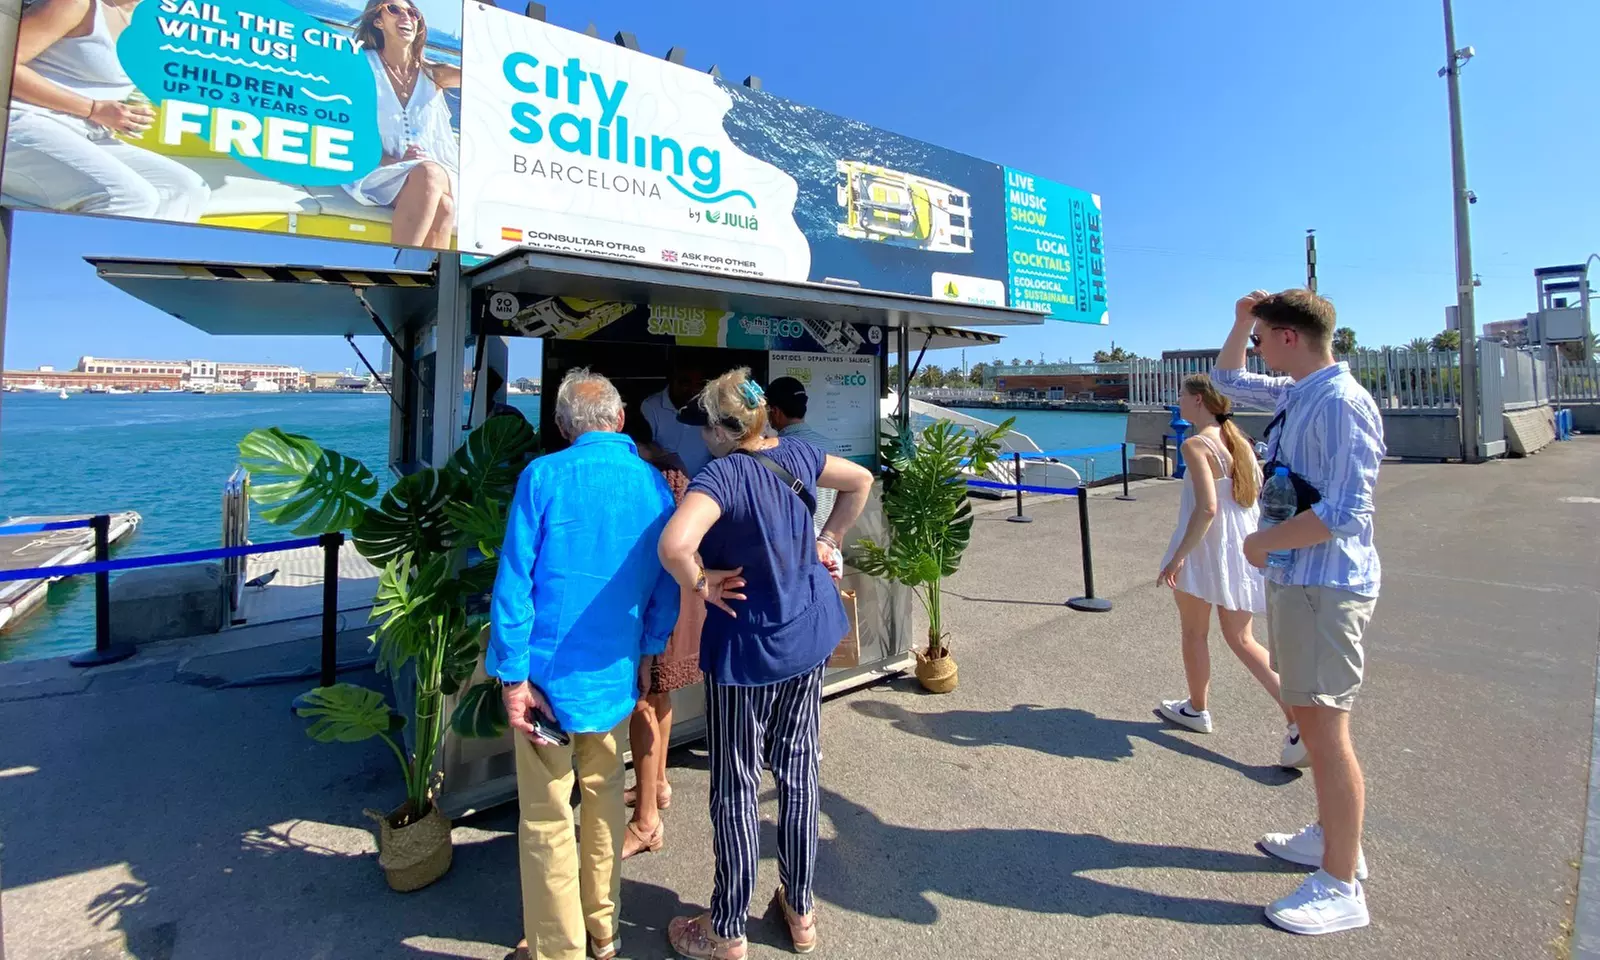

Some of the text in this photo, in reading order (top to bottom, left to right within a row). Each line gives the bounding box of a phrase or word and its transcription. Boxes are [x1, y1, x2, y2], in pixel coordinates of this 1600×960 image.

[159, 0, 365, 55] SAIL THE CITY
[157, 16, 297, 62] WITH US!
[163, 62, 295, 99] CHILDREN
[502, 51, 629, 127] city
[163, 80, 350, 124] UP TO 3 YEARS OLD
[158, 99, 354, 172] FREE
[509, 101, 721, 194] sailing
[512, 154, 662, 200] BARCELONA
[1008, 171, 1035, 192] LIVE
[1010, 189, 1047, 212] MUSIC
[689, 207, 701, 223] by
[1011, 206, 1047, 227] SHOW
[528, 230, 604, 247] CONSULTAR
[606, 241, 646, 253] OTRAS
[1036, 238, 1070, 257] LOCAL
[681, 252, 756, 268] ASK FOR OTHER
[1013, 251, 1071, 273] COCKTAILS
[1073, 200, 1087, 312] BUY TICKETS
[1088, 212, 1104, 302] HERE
[1014, 276, 1063, 292] ECOLOGICAL
[496, 298, 512, 307] 90
[1015, 288, 1076, 305] & SUSTAINABLE
[1015, 300, 1052, 313] SAILINGS
[769, 319, 804, 337] ECO
[844, 374, 866, 387] ECO
